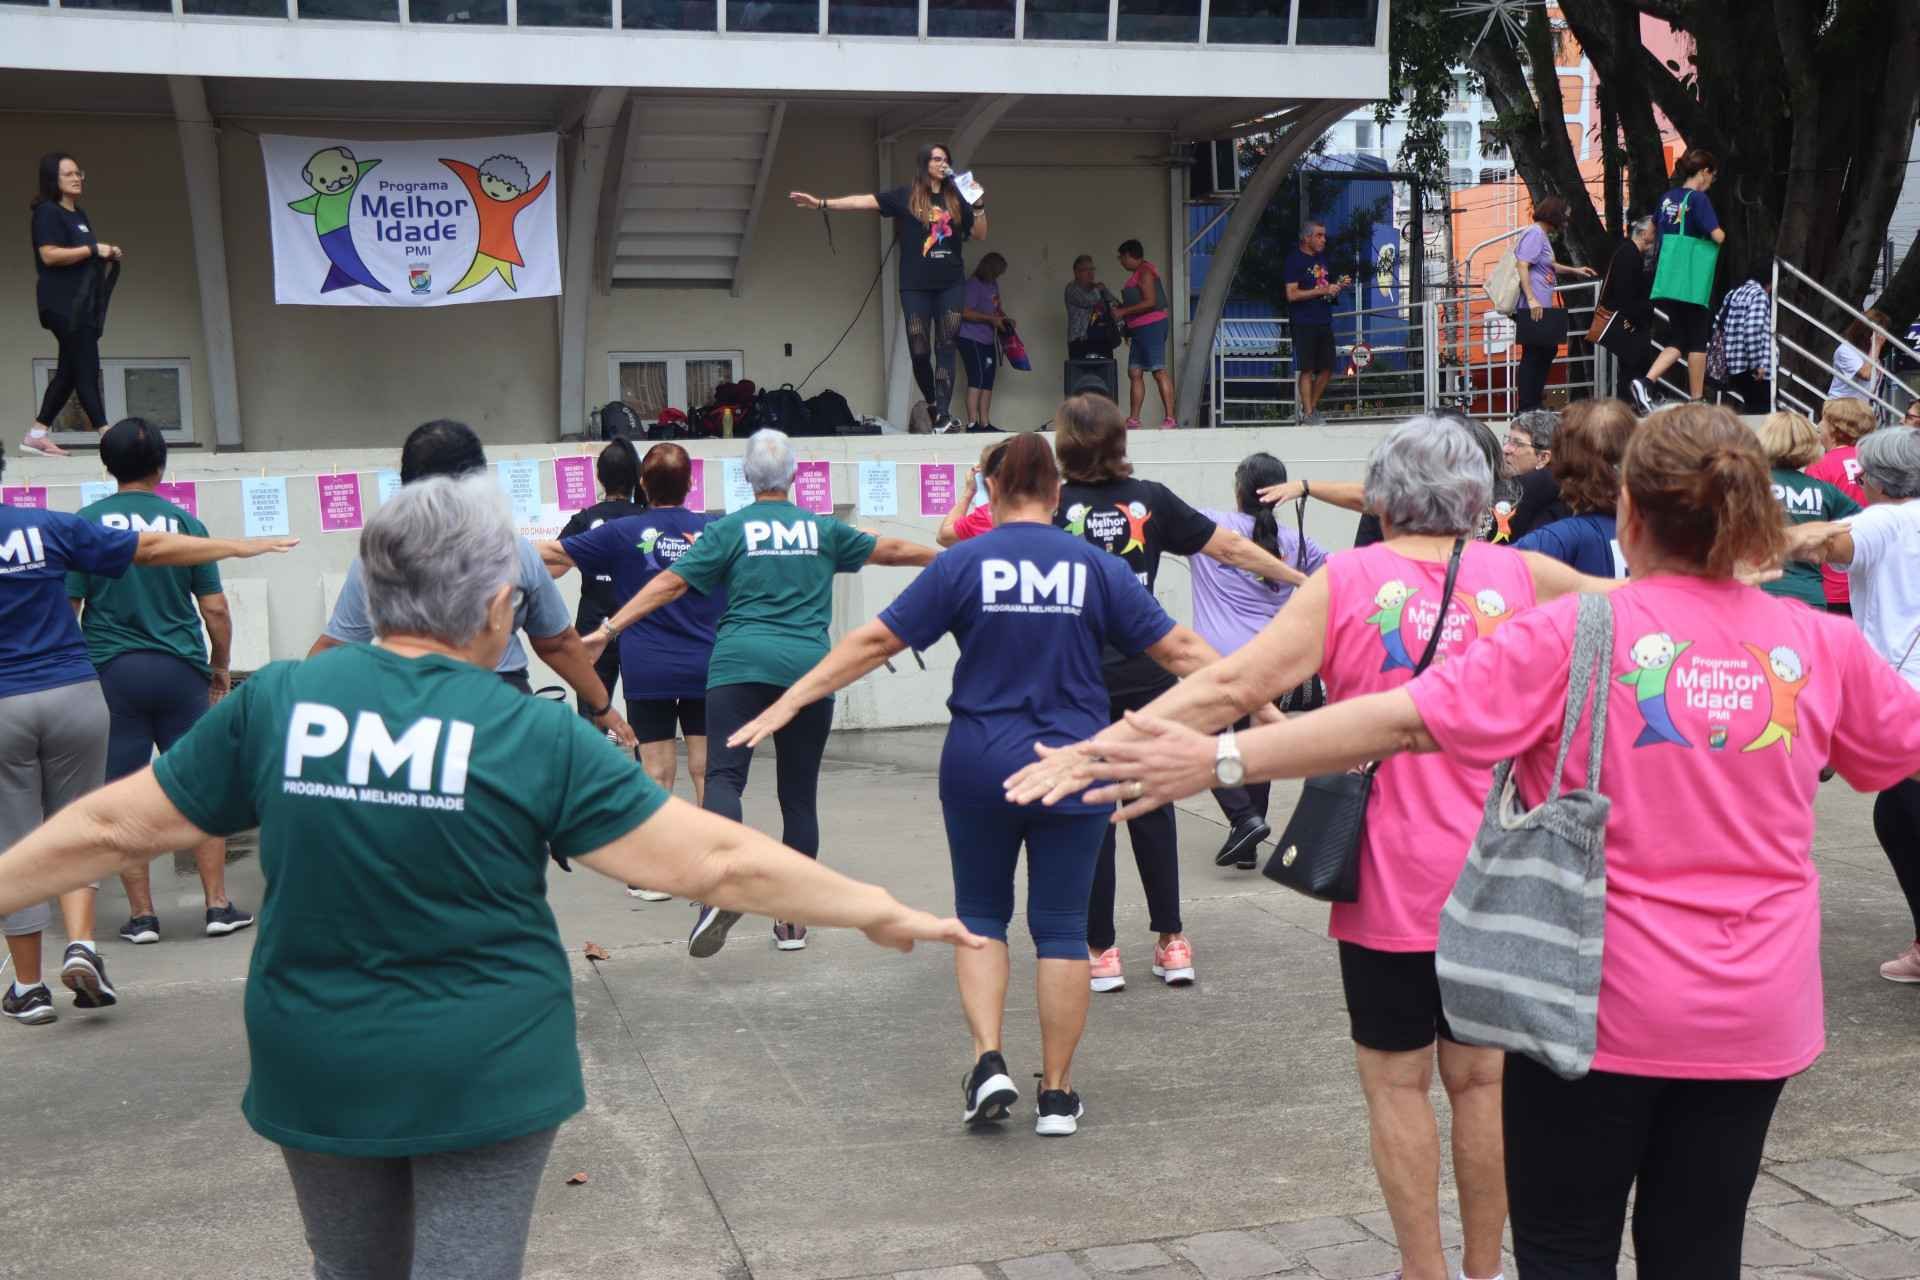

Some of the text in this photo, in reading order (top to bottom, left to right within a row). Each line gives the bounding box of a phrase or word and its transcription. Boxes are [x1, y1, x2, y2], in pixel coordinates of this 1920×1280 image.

[379, 180, 449, 194] Programa
[361, 194, 468, 218] Melhor
[376, 220, 457, 241] Idade
[405, 246, 431, 257] PMI
[1087, 517, 1126, 528] Melhor
[1093, 527, 1123, 537] Idade
[744, 520, 818, 551] PMI
[981, 558, 1087, 607] PMI
[982, 604, 1028, 613] PROGRAMA
[1029, 605, 1061, 613] MELHOR
[1692, 656, 1748, 669] Programa
[1676, 667, 1765, 691] Melhor
[1686, 690, 1753, 710] Idade
[1708, 711, 1730, 721] PMI
[284, 702, 475, 794] PMI
[283, 780, 464, 811] PROGRAMA MELHOR IDADE
